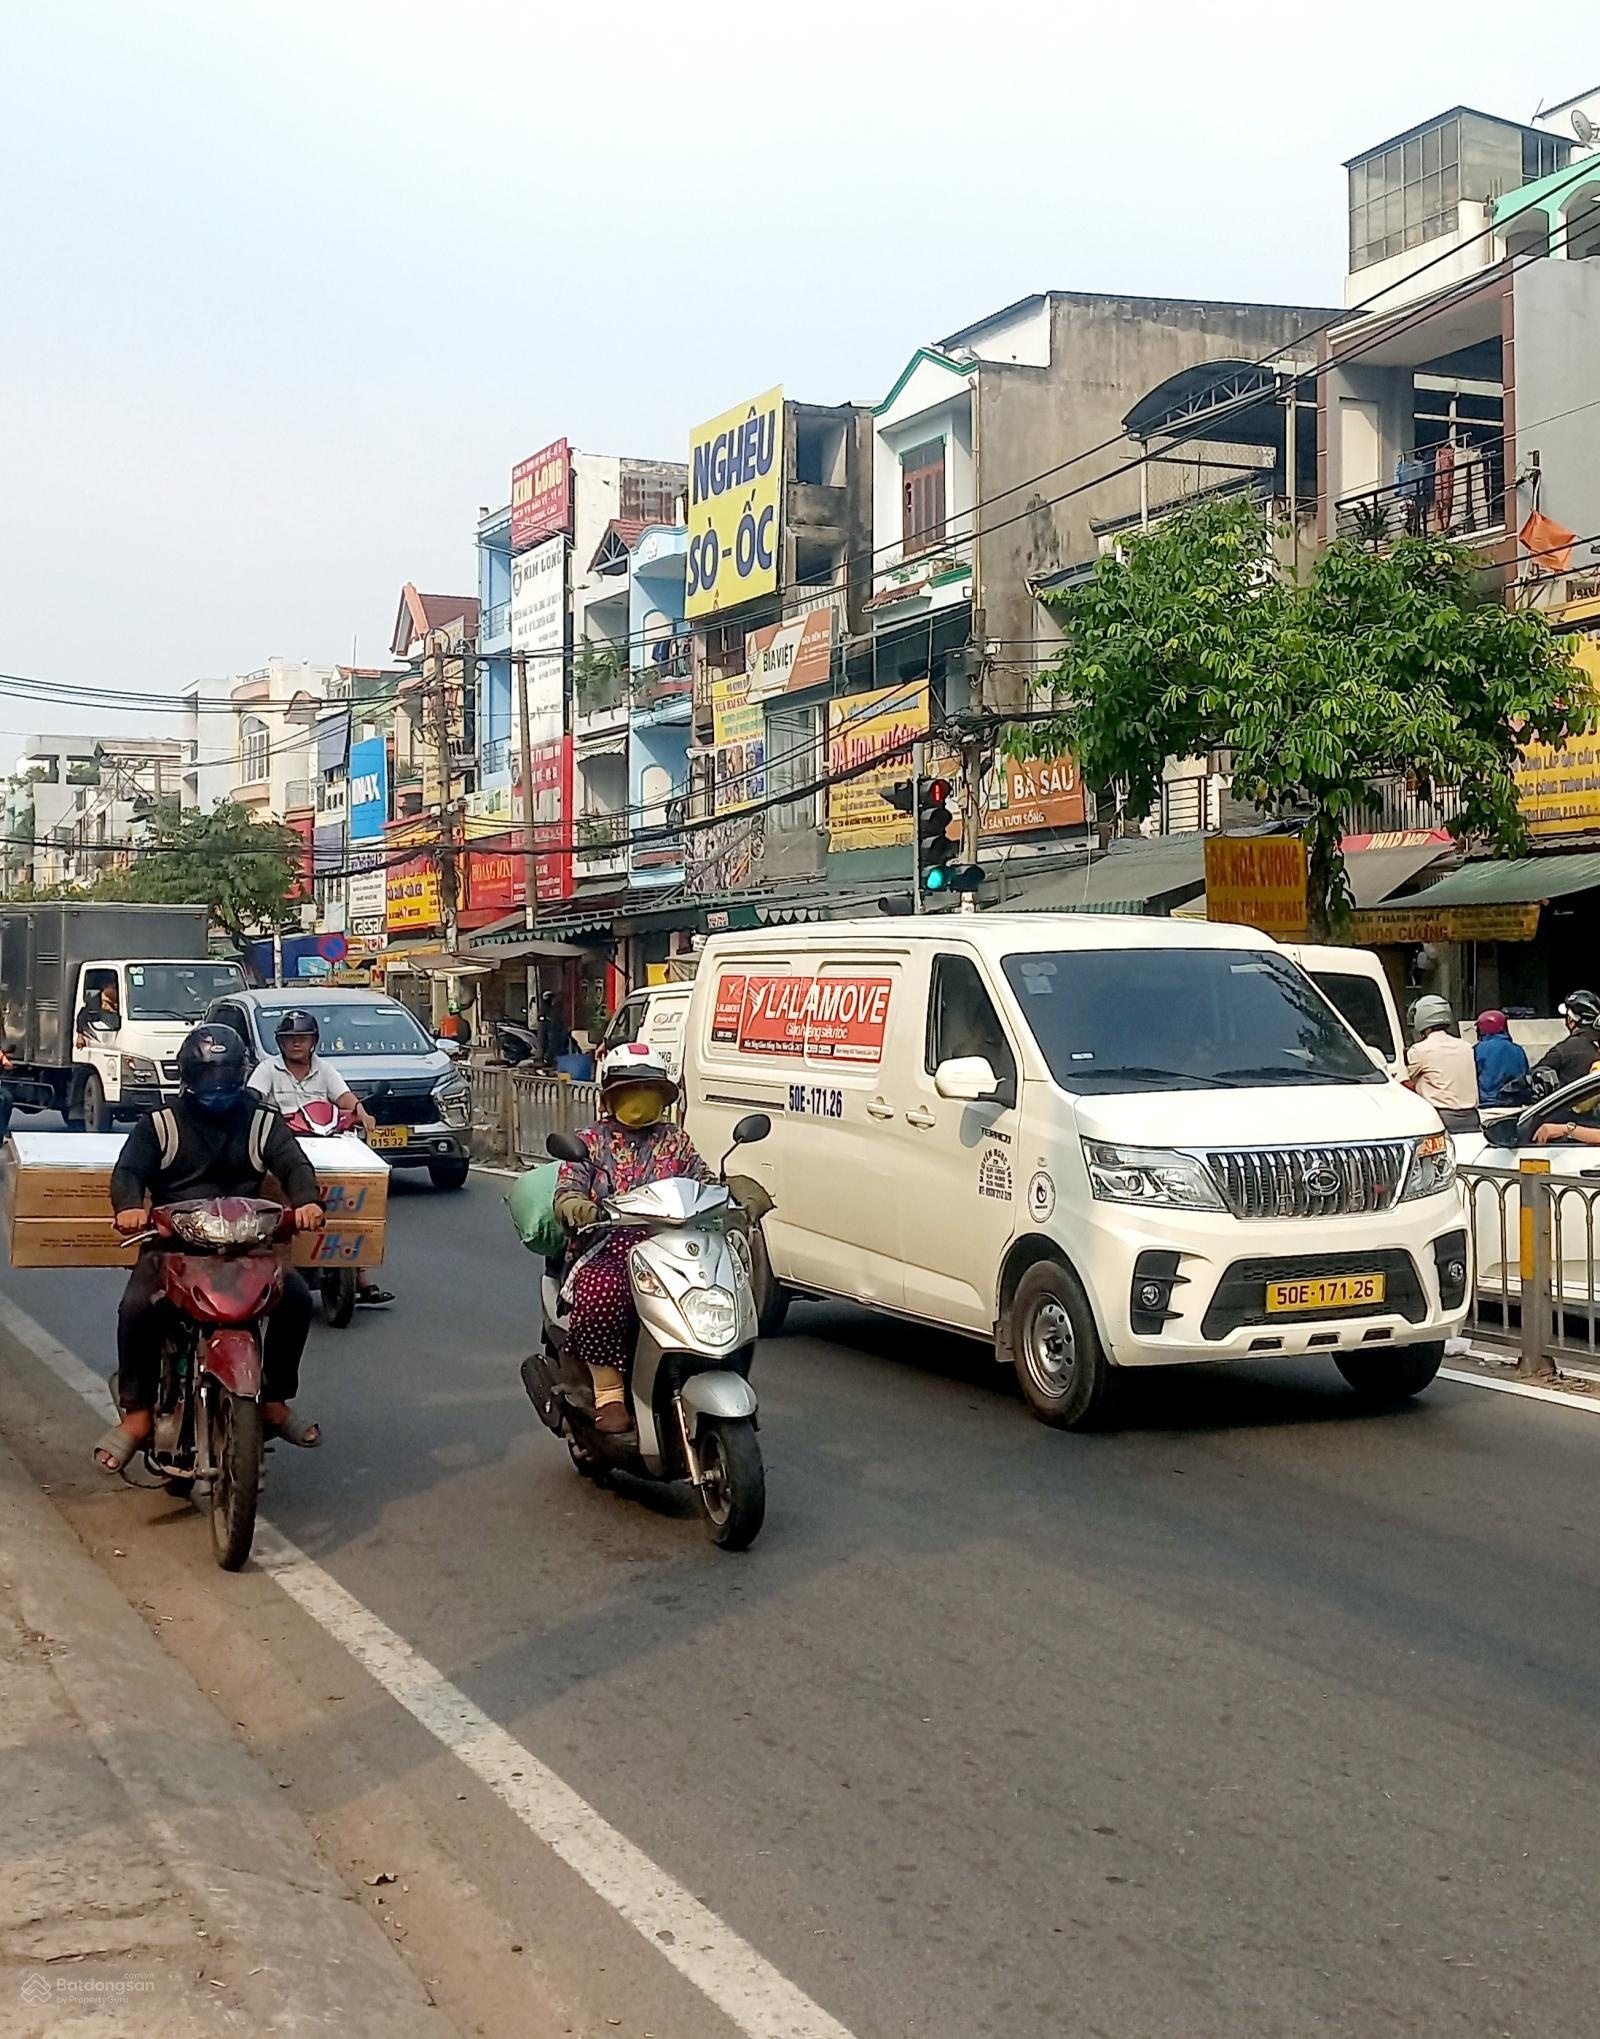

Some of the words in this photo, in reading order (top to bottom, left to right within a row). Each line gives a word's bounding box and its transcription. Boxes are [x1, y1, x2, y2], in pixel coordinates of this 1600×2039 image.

[693, 405, 776, 505] NGHÊU
[513, 472, 533, 508] KIM
[534, 458, 563, 497] LONG
[523, 563, 539, 582] KIM
[541, 550, 562, 575] LONG
[763, 649, 776, 673] BIA
[776, 642, 795, 669] VIỆT
[1013, 766, 1037, 800] BÀ
[1040, 761, 1074, 796] SÁU
[764, 982, 890, 1025] LALAMOVE
[789, 1085, 843, 1118] 50E-171.26
[1276, 1280, 1374, 1305] 50E-171.26
